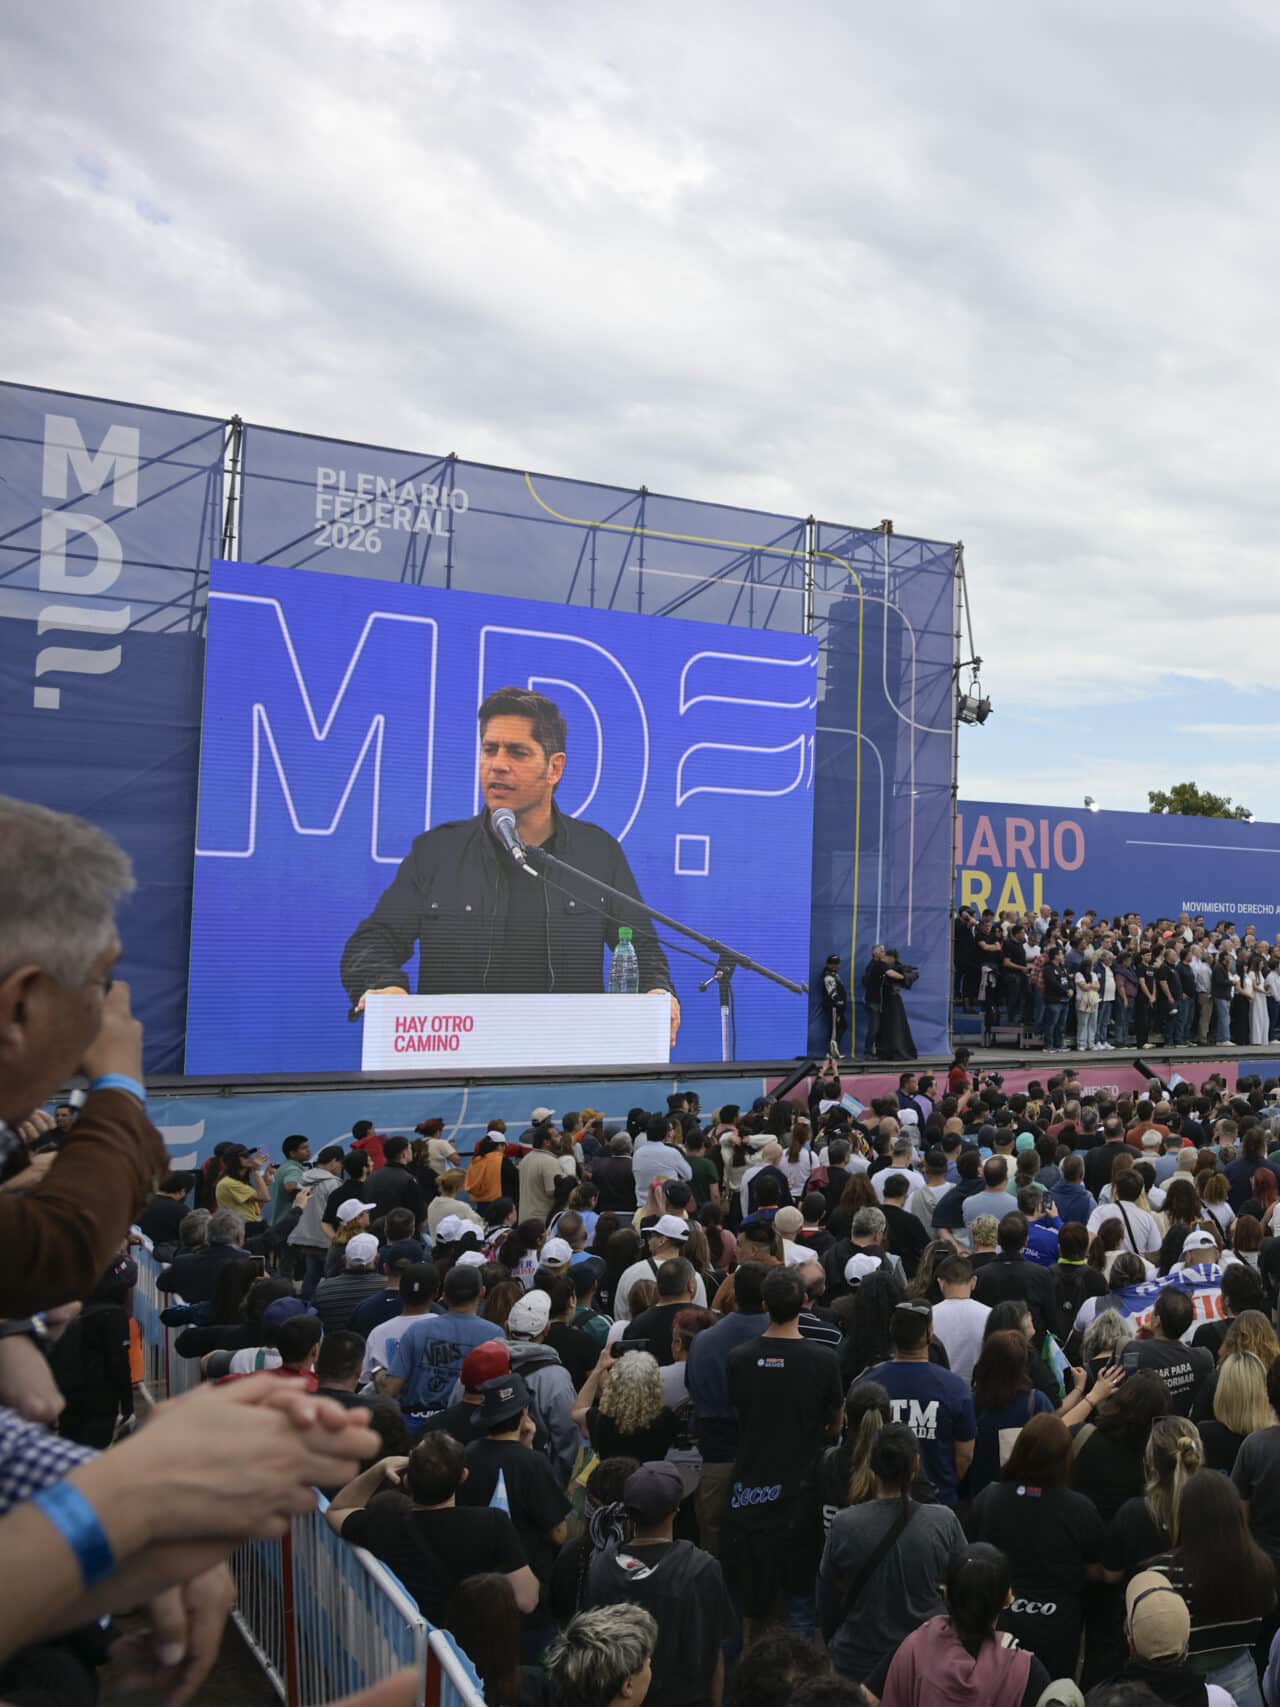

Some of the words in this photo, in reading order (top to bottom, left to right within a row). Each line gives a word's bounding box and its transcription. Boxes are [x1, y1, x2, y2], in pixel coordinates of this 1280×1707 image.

[316, 466, 470, 514] PLENARIO
[315, 492, 451, 538] FEDERAL
[313, 519, 382, 554] 2026
[1182, 901, 1235, 913] MOVIMIENTO
[1237, 903, 1274, 915] DERECHO
[395, 1015, 428, 1033] HAY
[431, 1015, 475, 1033] OTRO
[394, 1034, 460, 1053] CAMINO
[731, 1482, 784, 1508] Secco
